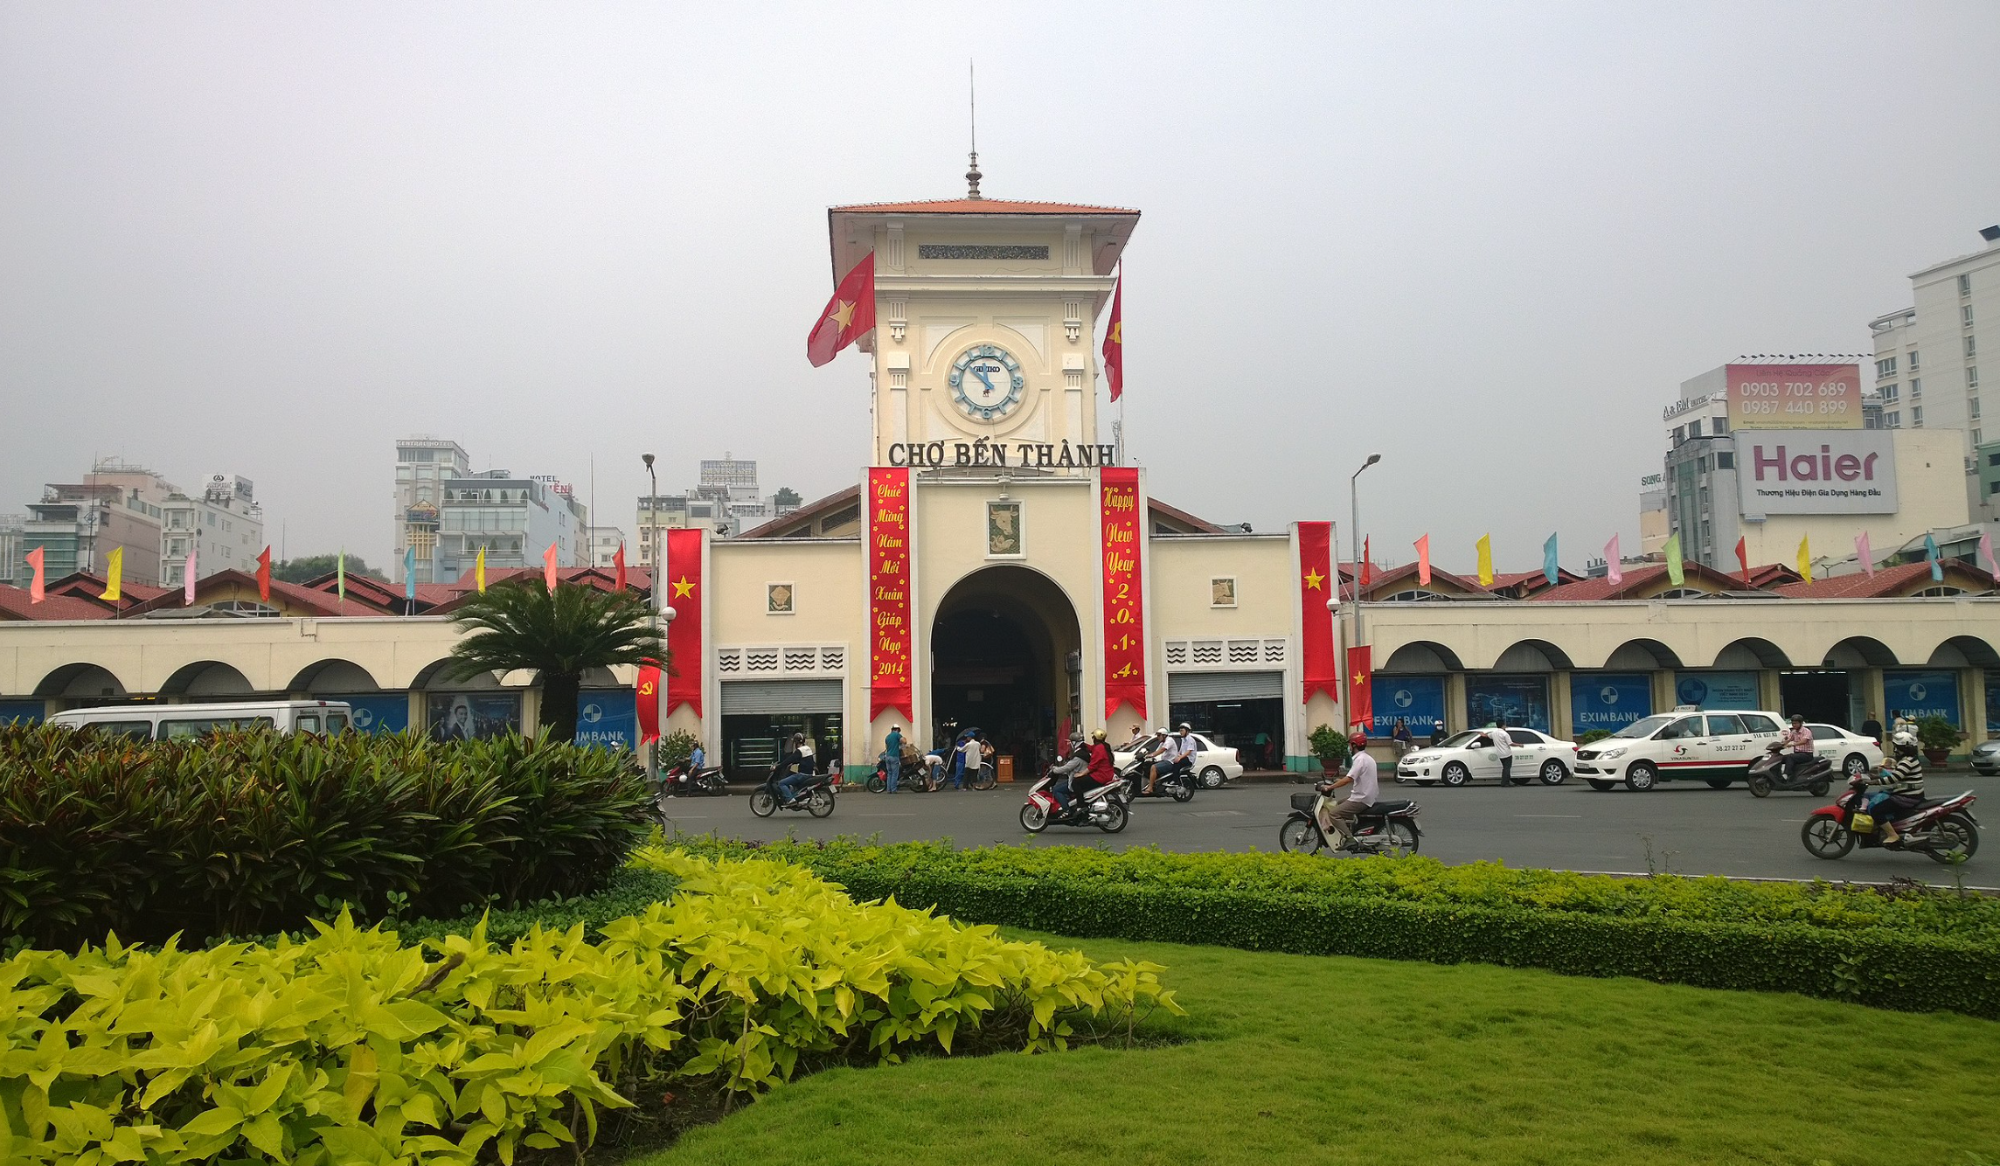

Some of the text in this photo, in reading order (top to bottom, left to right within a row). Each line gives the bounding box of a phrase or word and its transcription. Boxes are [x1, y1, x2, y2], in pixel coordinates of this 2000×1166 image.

[978, 345, 994, 357] 12
[950, 374, 959, 387] 9
[1013, 376, 1023, 389] 3
[1740, 382, 1847, 396] 0903 702 689
[982, 408, 992, 419] 6
[1742, 401, 1847, 414] 0987 440 899
[888, 436, 1114, 469] CHỢ BẾN THÀNH
[1753, 444, 1878, 481] Haier
[1641, 473, 1661, 486] SONG
[877, 484, 901, 498] Chúc
[1757, 487, 1881, 498] Thương Hiệu Điện Gia Dụng Hàng Đầu
[1104, 487, 1134, 512] Happy
[875, 509, 904, 524] Mừng
[1106, 522, 1133, 542] New
[877, 533, 903, 548] Năm
[879, 559, 900, 574] Mới
[1106, 551, 1135, 576] Year
[875, 586, 903, 600] Xuân
[877, 611, 902, 628] Giáp
[879, 637, 901, 655] Ngọ
[878, 662, 903, 675] 2014
[1580, 712, 1640, 722] EXIMBANK
[576, 731, 624, 741] IMBANK
